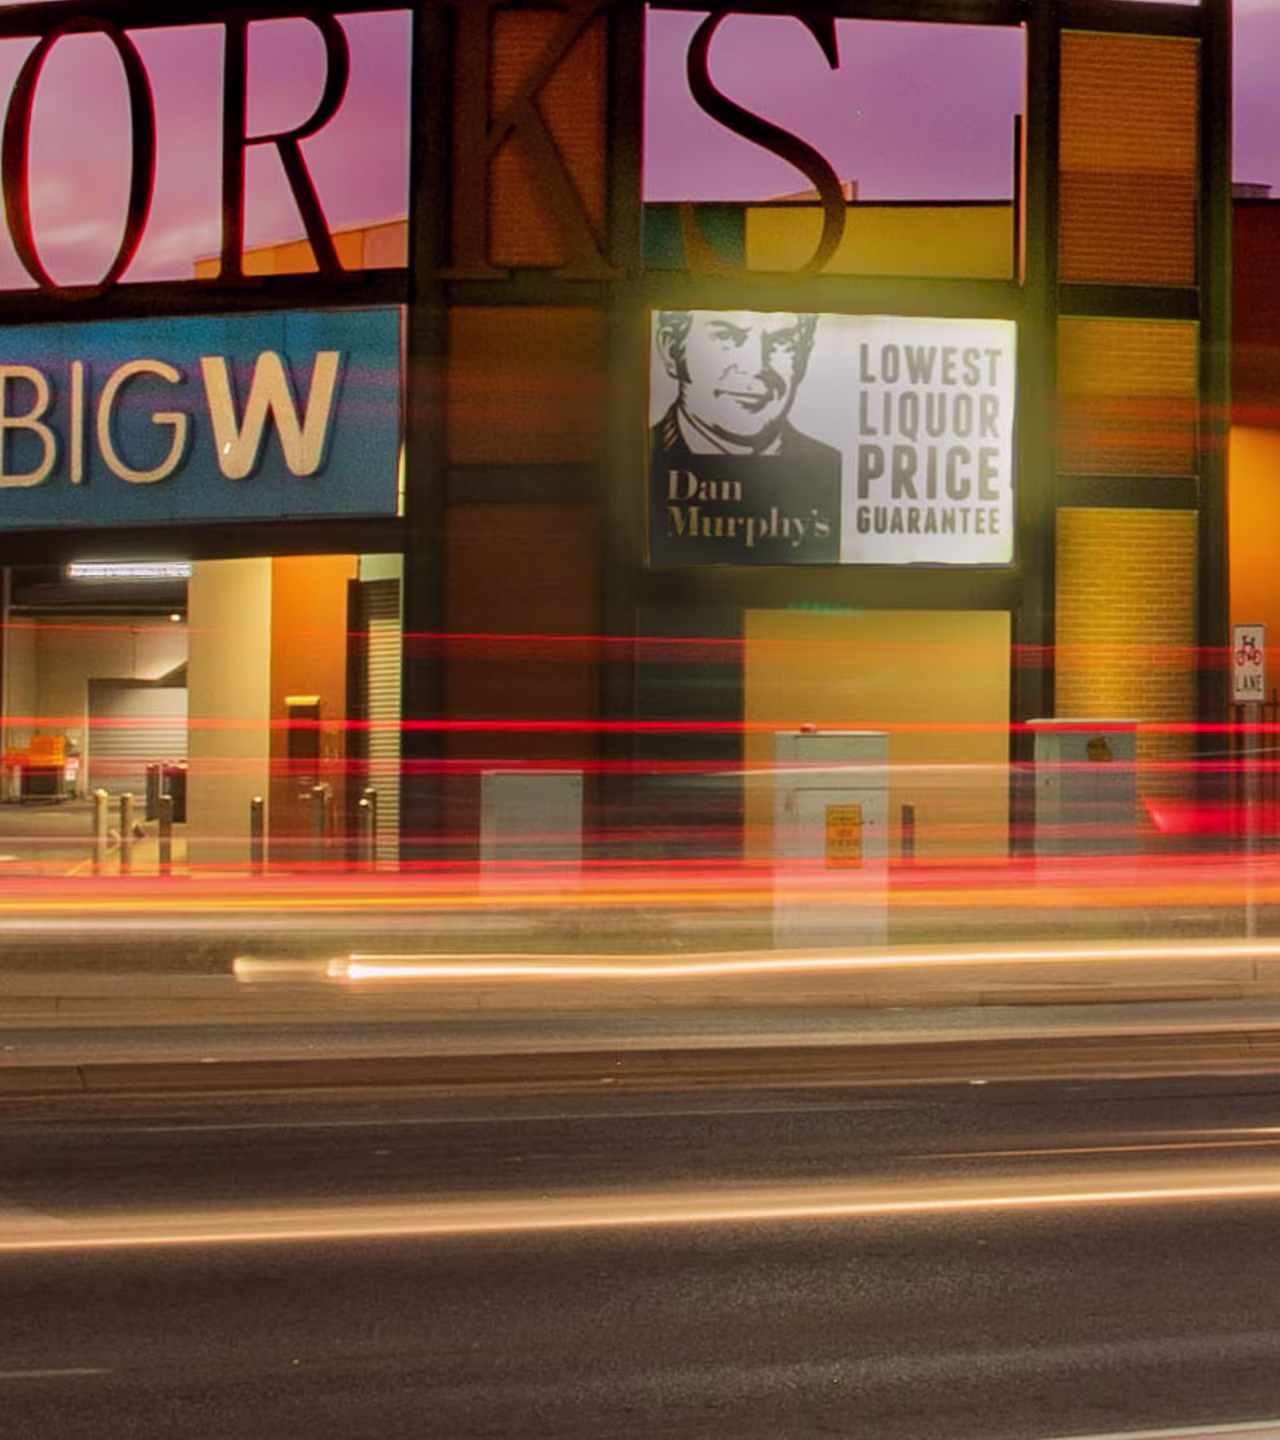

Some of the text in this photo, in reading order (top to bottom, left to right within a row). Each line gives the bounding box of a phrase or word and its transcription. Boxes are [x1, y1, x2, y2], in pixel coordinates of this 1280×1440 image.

[859, 343, 1002, 386] LOWEST
[858, 391, 1000, 442] LIQUOR
[668, 469, 742, 501] Dan
[857, 444, 1000, 500] PRICE
[667, 506, 831, 548] Murphy's
[856, 506, 1000, 535] GUARANTEE
[1236, 674, 1262, 693] LANE
